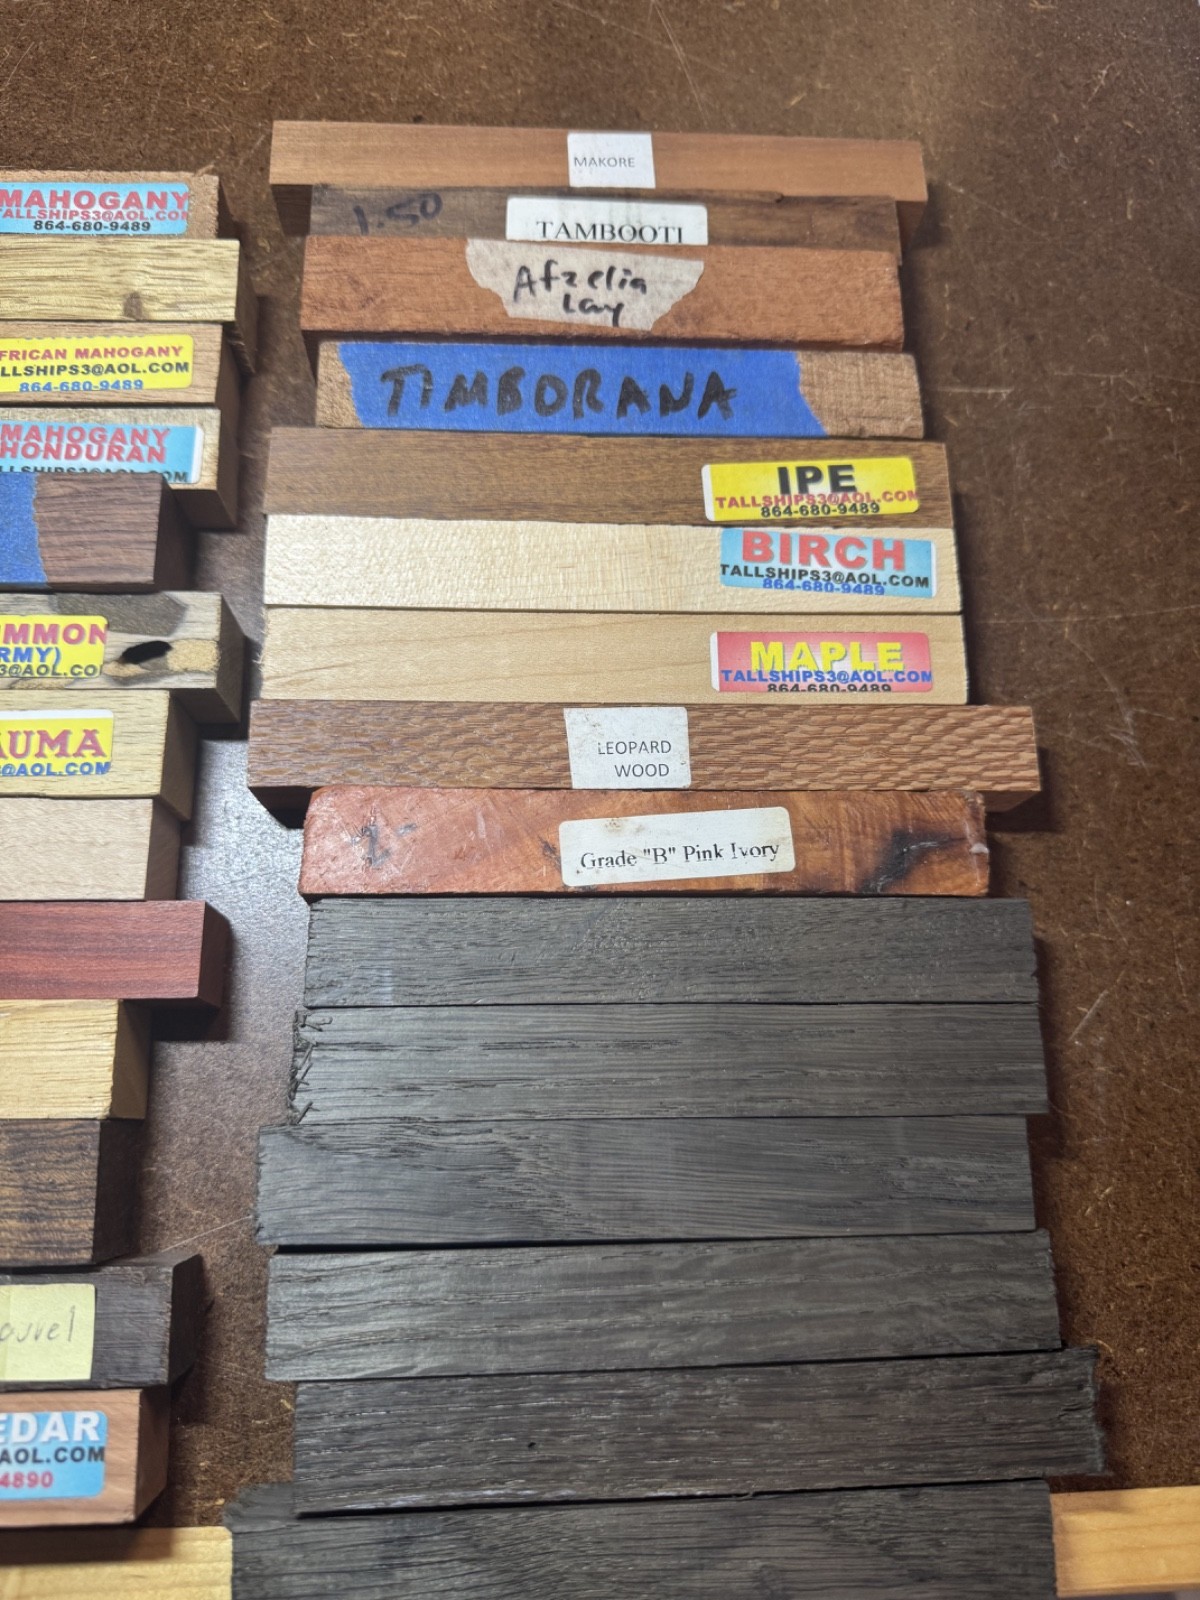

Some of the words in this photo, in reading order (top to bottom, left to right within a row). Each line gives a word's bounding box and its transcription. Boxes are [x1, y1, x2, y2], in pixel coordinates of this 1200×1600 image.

[573, 155, 636, 169] MAKORE
[0, 189, 189, 210] MAHOGANY
[0, 208, 188, 222] ALLSHIPS3@AOL.CO
[33, 220, 151, 232] 864-680-9489
[536, 220, 685, 244] TAMBOOTI
[75, 345, 184, 360] MAHOGANY
[19, 379, 144, 392] 864-680-9489
[381, 363, 738, 421] TIMBORANA
[0, 424, 171, 446] MAHOGANY
[0, 441, 166, 464] HONDURAN
[777, 464, 858, 496] IPE
[715, 490, 918, 510] TALLSHIPS3@AOL.COM
[761, 502, 881, 518] 864-680-9489
[742, 530, 906, 572] BIRCH
[720, 563, 930, 588] TALLSHIPS3@AOL.COM
[762, 577, 885, 596] 864-680-9489
[750, 641, 905, 673] MAPLE
[720, 669, 932, 684] TALLSHIPS3@AOL.COM
[767, 683, 892, 693] 864-680-9489
[0, 729, 107, 759] UMA
[597, 740, 672, 755] LEOPARD
[0, 761, 111, 777] @AOL.COM
[614, 763, 670, 778] WOOD
[580, 849, 638, 869] Grade
[643, 847, 677, 865] "B"
[682, 843, 724, 864] Pink
[731, 842, 780, 862] Ivory
[0, 1471, 54, 1489] 4890
